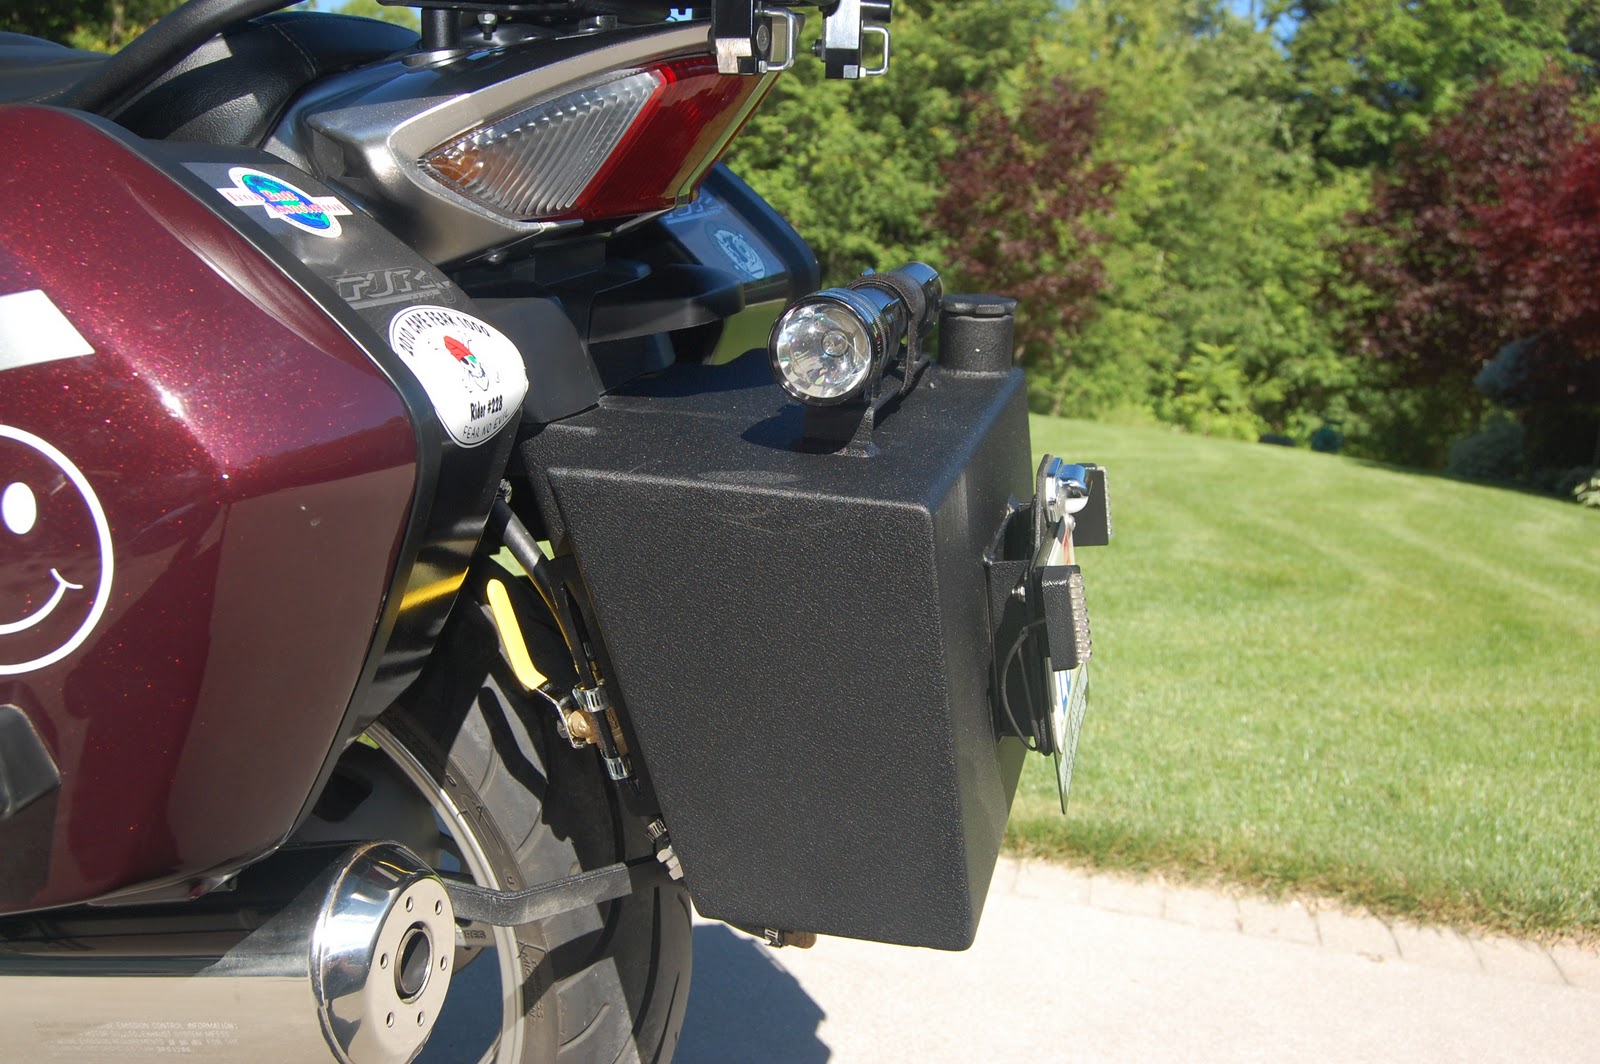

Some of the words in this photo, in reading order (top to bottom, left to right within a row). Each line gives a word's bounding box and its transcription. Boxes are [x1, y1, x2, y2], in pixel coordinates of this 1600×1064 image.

[405, 313, 432, 334] CAPE
[424, 311, 458, 326] FEAR
[456, 316, 490, 337] 1000
[470, 401, 486, 422] Rider
[463, 425, 480, 439] FEAR
